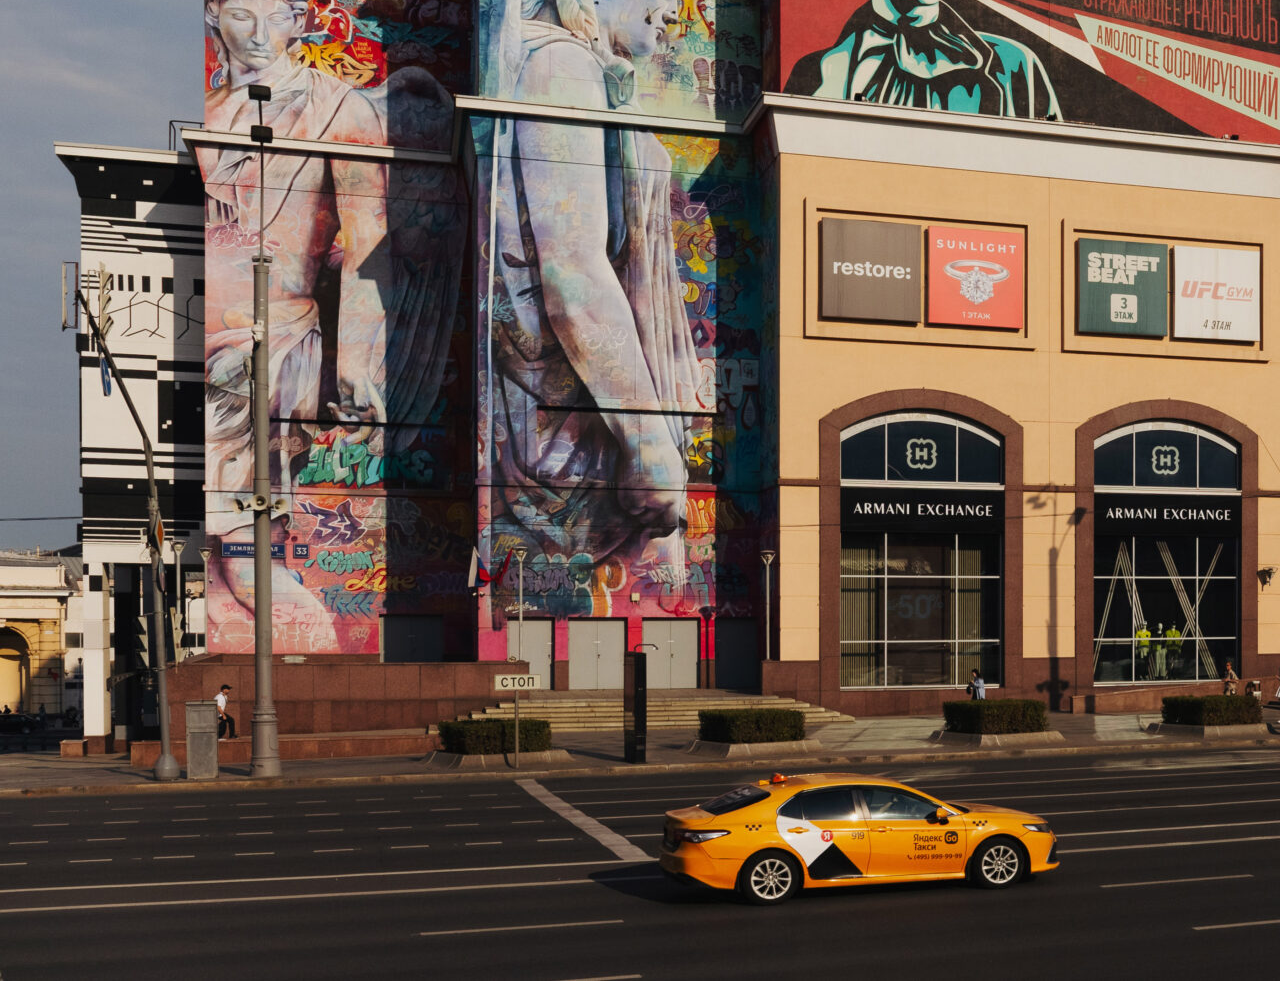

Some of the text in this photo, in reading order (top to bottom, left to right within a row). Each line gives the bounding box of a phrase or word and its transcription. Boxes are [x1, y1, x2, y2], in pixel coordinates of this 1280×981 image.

[1097, 25, 1278, 120] А МОЛОТ ЕЕ ФОРМИРУЮЩИЙ
[936, 238, 1017, 254] SUNLIGHT
[1088, 251, 1160, 272] STREET
[1088, 267, 1138, 285] BEAT
[1181, 280, 1254, 300] UFC GYM
[1120, 297, 1128, 309] 3
[968, 311, 991, 320] ЭТАЖ
[1114, 311, 1134, 320] ЭТАЖ
[1203, 319, 1232, 330] 4 ЭТАЖ
[853, 501, 993, 517] ARMANI EXCHANGE
[1106, 507, 1232, 521] ARMANI EXCHANGE
[296, 547, 307, 555] 33
[500, 677, 535, 688] СТОП
[913, 833, 957, 843] Яндекс Go
[914, 843, 936, 851] Такси
